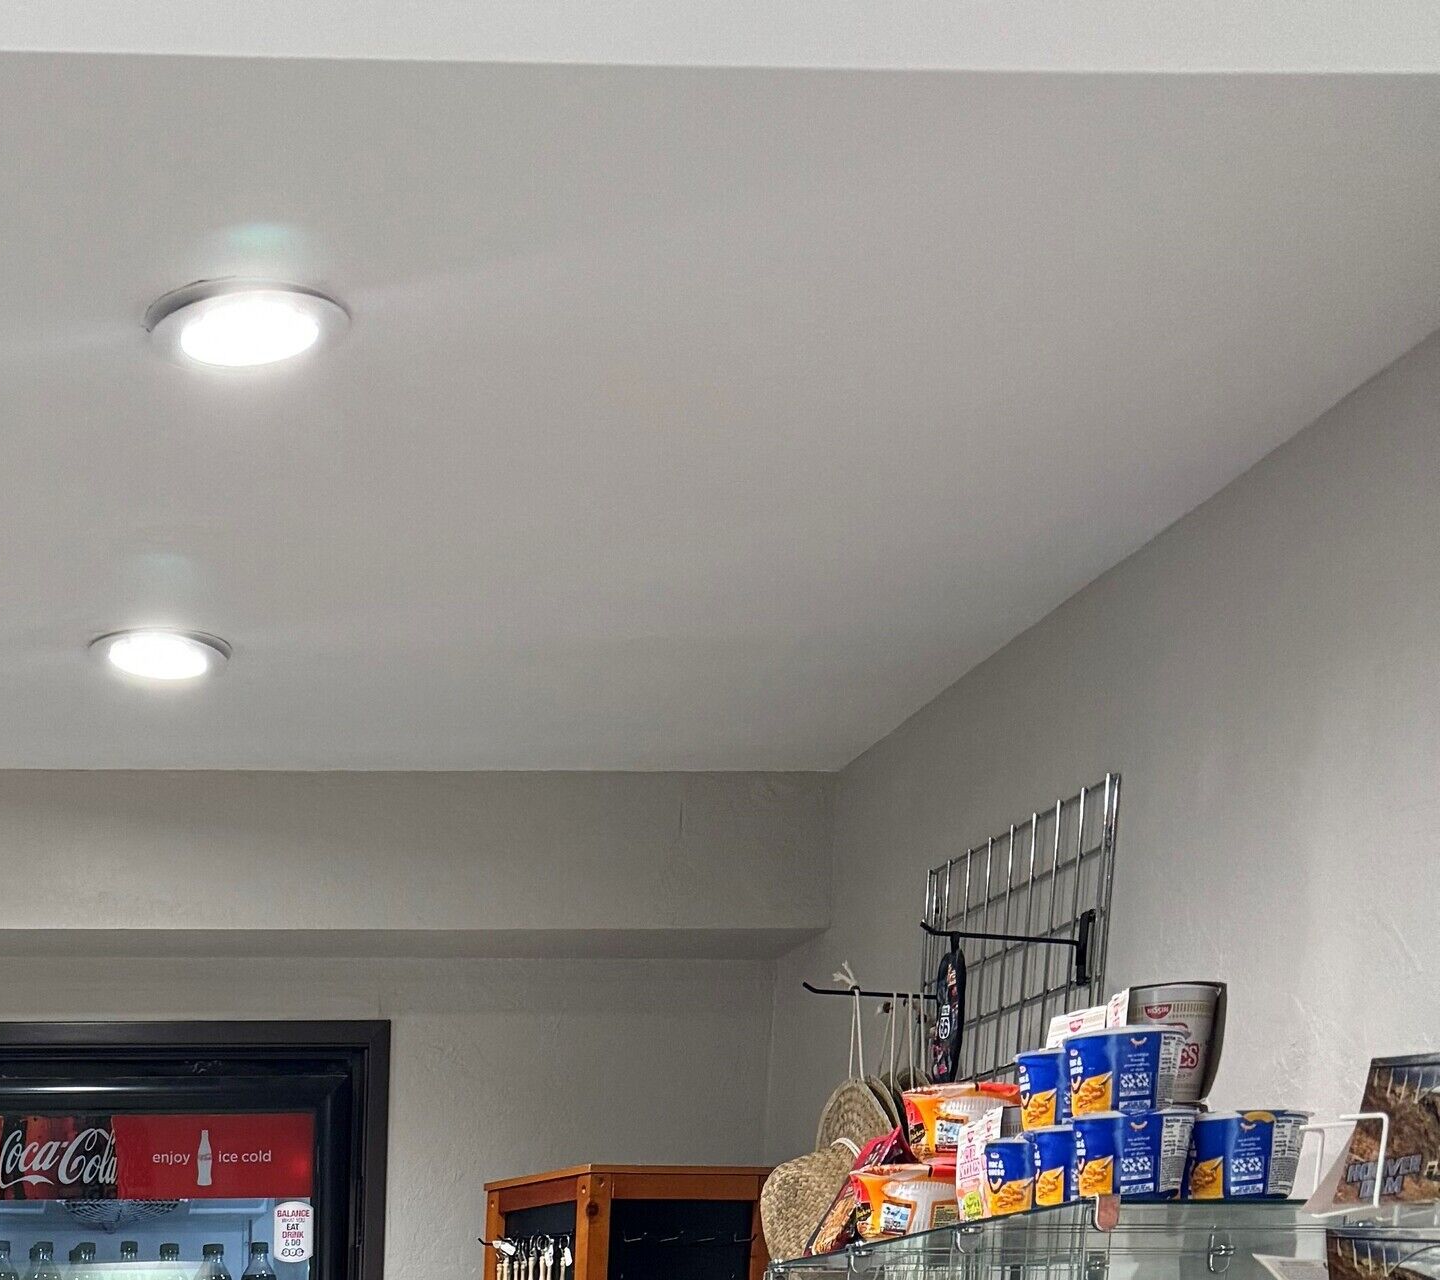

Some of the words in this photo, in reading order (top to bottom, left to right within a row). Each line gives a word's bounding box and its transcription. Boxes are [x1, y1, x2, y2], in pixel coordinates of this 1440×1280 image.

[152, 1151, 190, 1166] enjoy
[218, 1150, 238, 1162] ice
[241, 1150, 272, 1162] cold
[1359, 1174, 1405, 1198] DM
[277, 1209, 310, 1217] BALANCE
[286, 1223, 299, 1231] EAT
